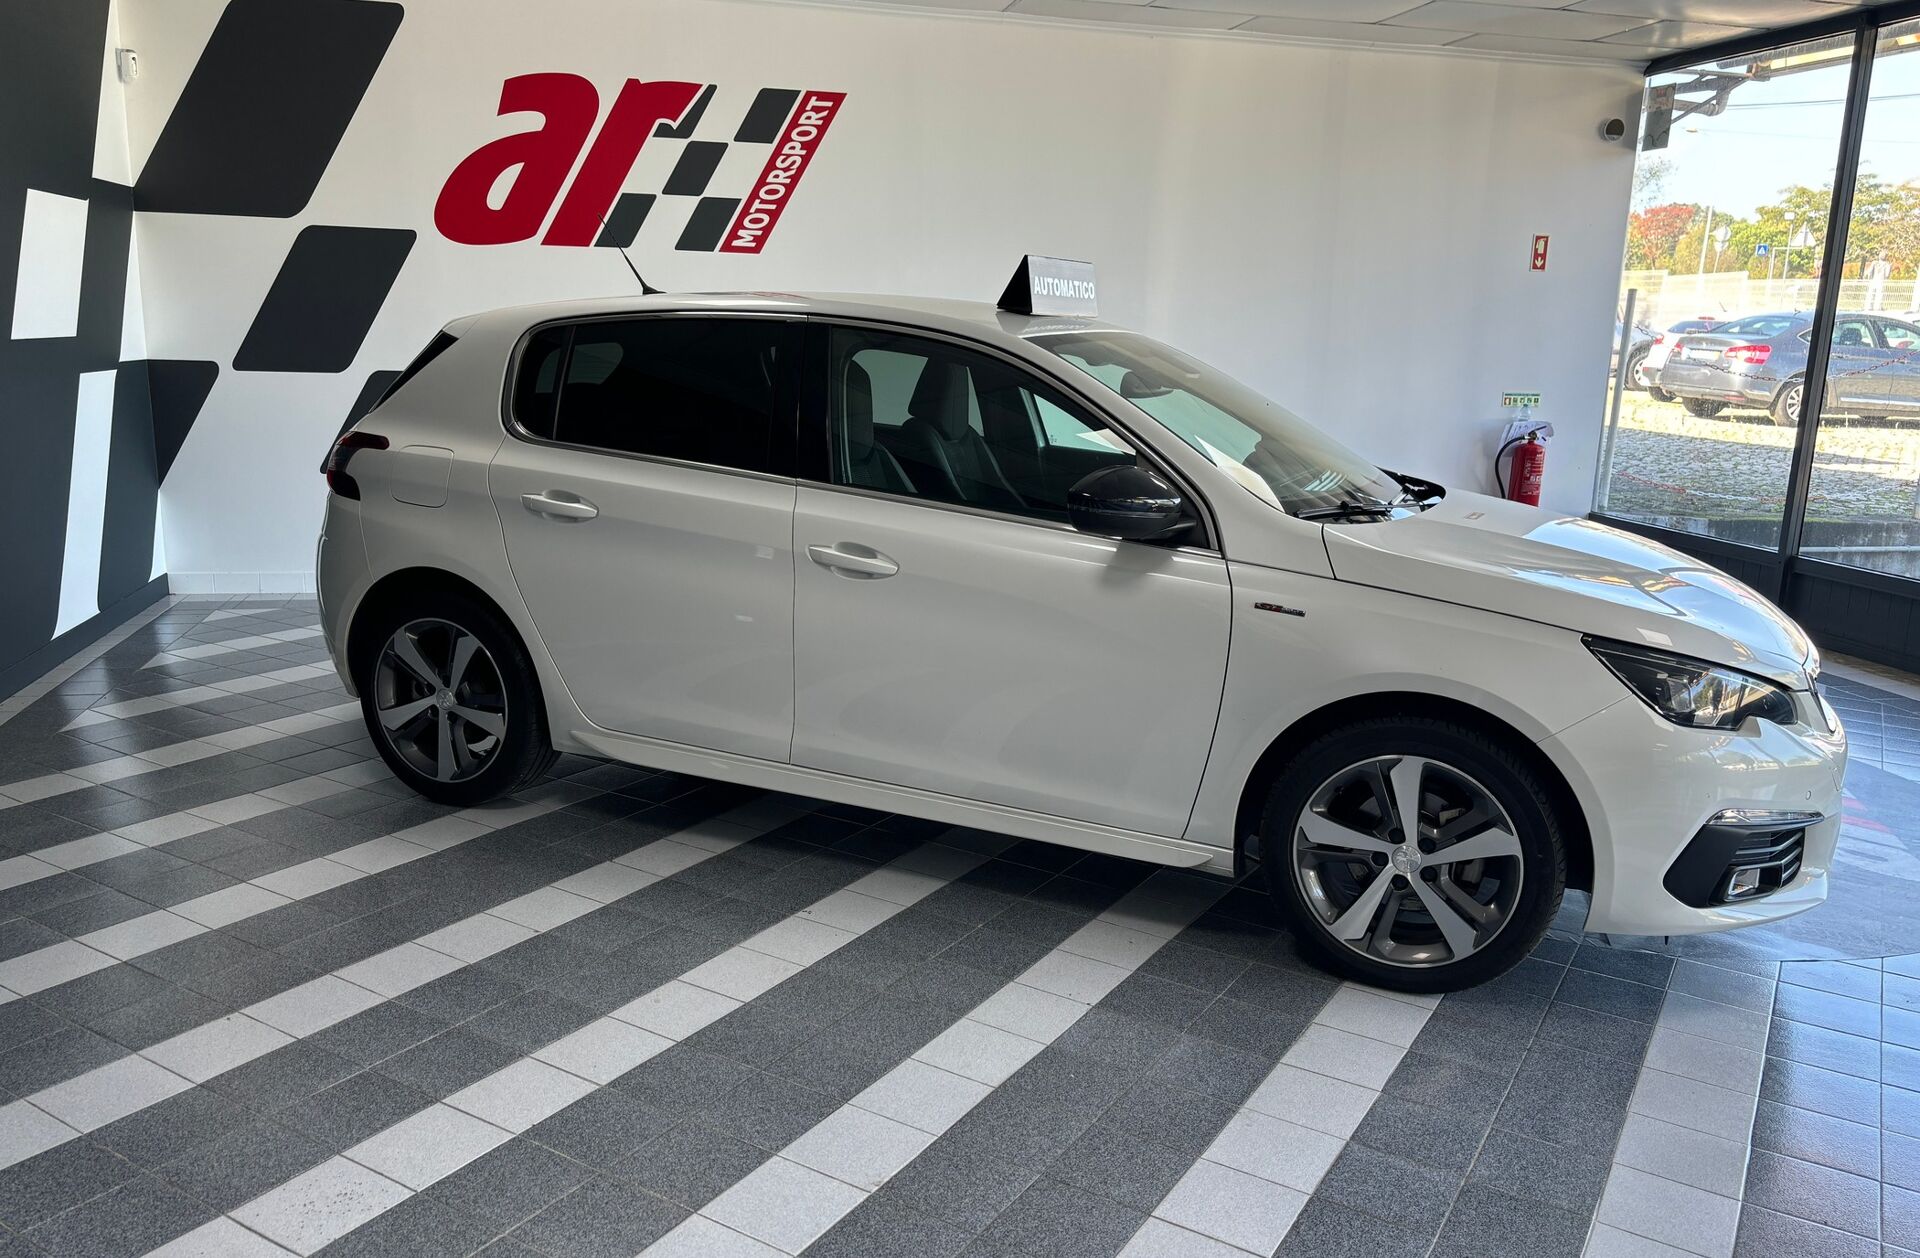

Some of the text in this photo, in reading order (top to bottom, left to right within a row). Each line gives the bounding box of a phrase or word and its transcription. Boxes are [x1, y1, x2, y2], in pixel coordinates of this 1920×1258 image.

[434, 72, 703, 247] ar
[731, 96, 834, 248] MOTORSPORT
[1034, 276, 1095, 299] AUTOMATICO
